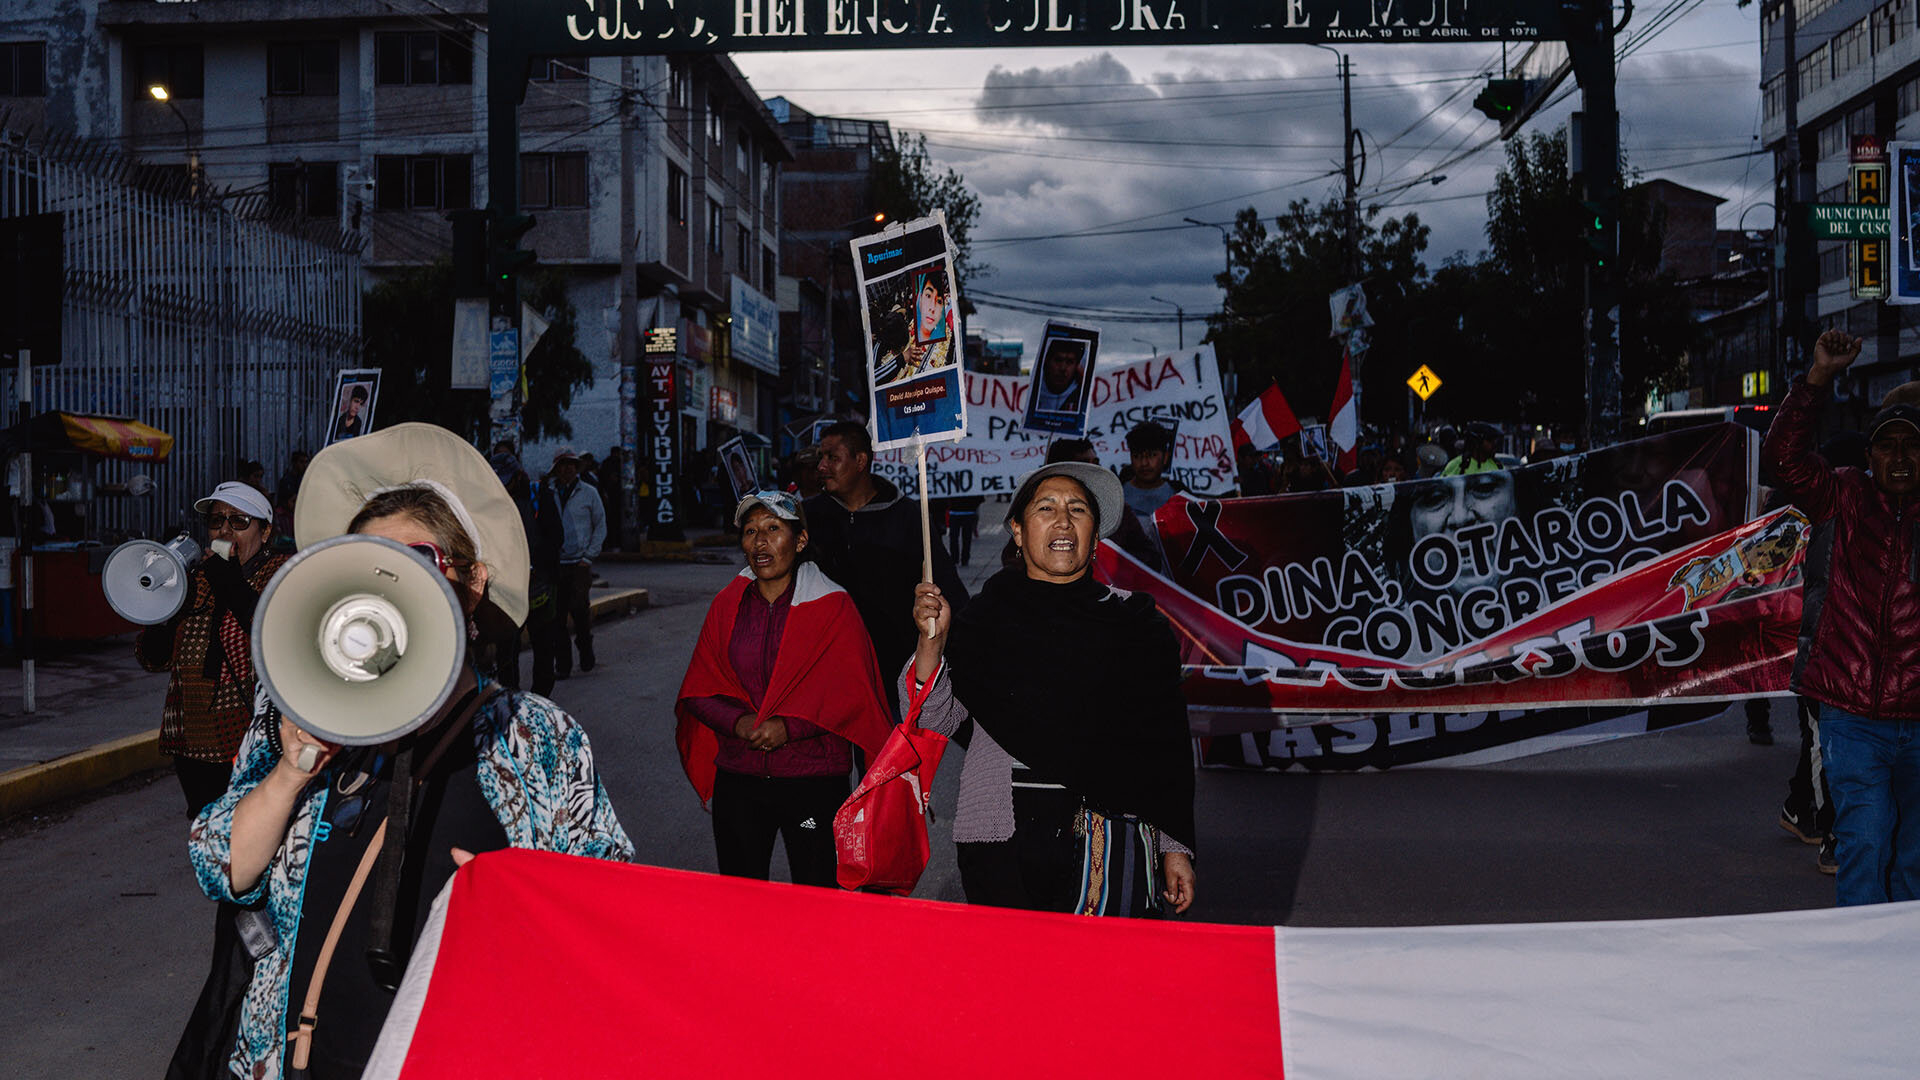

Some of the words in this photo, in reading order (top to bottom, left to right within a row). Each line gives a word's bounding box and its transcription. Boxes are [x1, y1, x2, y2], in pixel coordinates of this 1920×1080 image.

[1326, 29, 1373, 39] ITALIA,
[1379, 29, 1393, 38] 19
[1402, 28, 1421, 37] DE
[1431, 28, 1471, 37] ABRIL
[1481, 28, 1499, 37] DE
[1510, 27, 1538, 36] 1978
[1829, 221, 1852, 234] DEL
[867, 247, 903, 264] Apurimac
[981, 476, 1004, 490] DE
[1216, 549, 1403, 628] DINA,
[1409, 479, 1711, 591] OTAROLA
